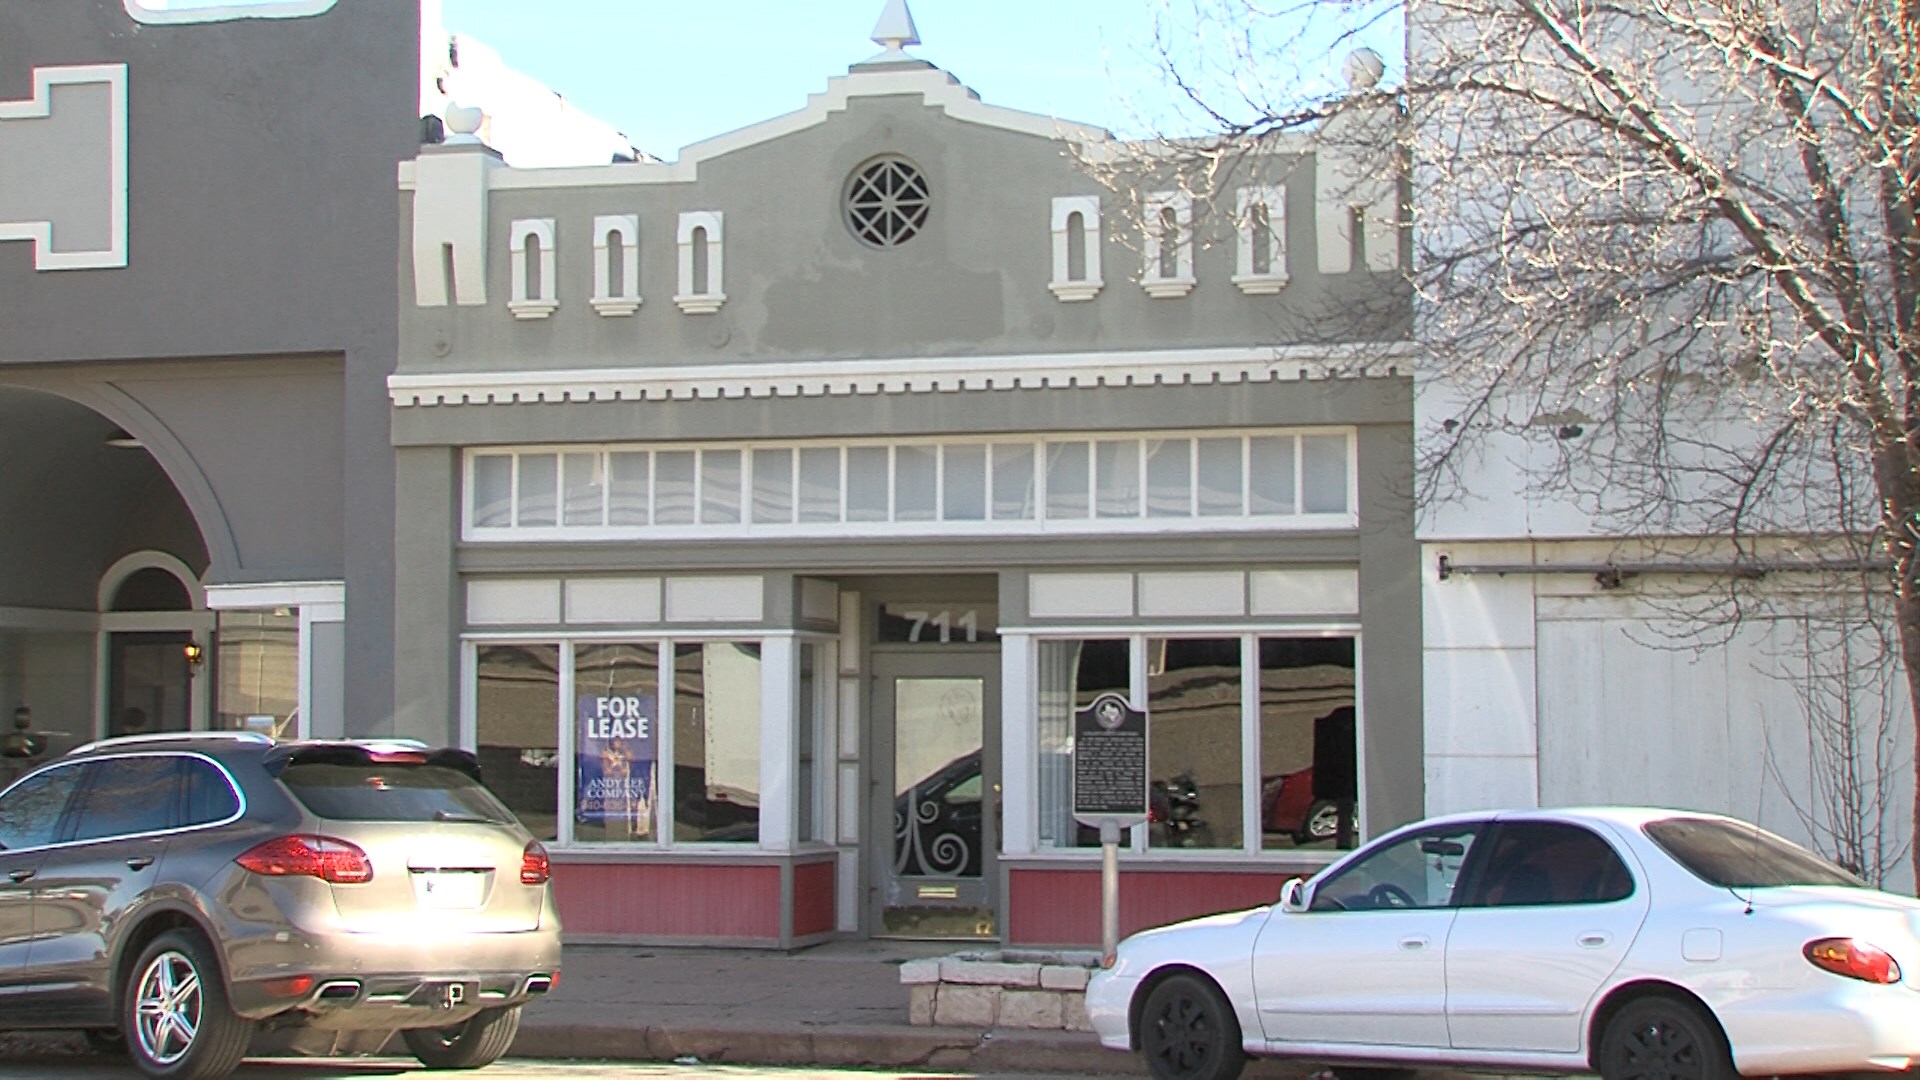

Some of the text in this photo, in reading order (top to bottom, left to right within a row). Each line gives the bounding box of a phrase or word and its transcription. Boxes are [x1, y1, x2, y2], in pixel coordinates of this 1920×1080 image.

[904, 610, 977, 642] 711
[597, 697, 640, 718] FOR
[588, 717, 649, 738] LEASE
[587, 789, 646, 798] COMPANY
[589, 779, 622, 788] ANDY
